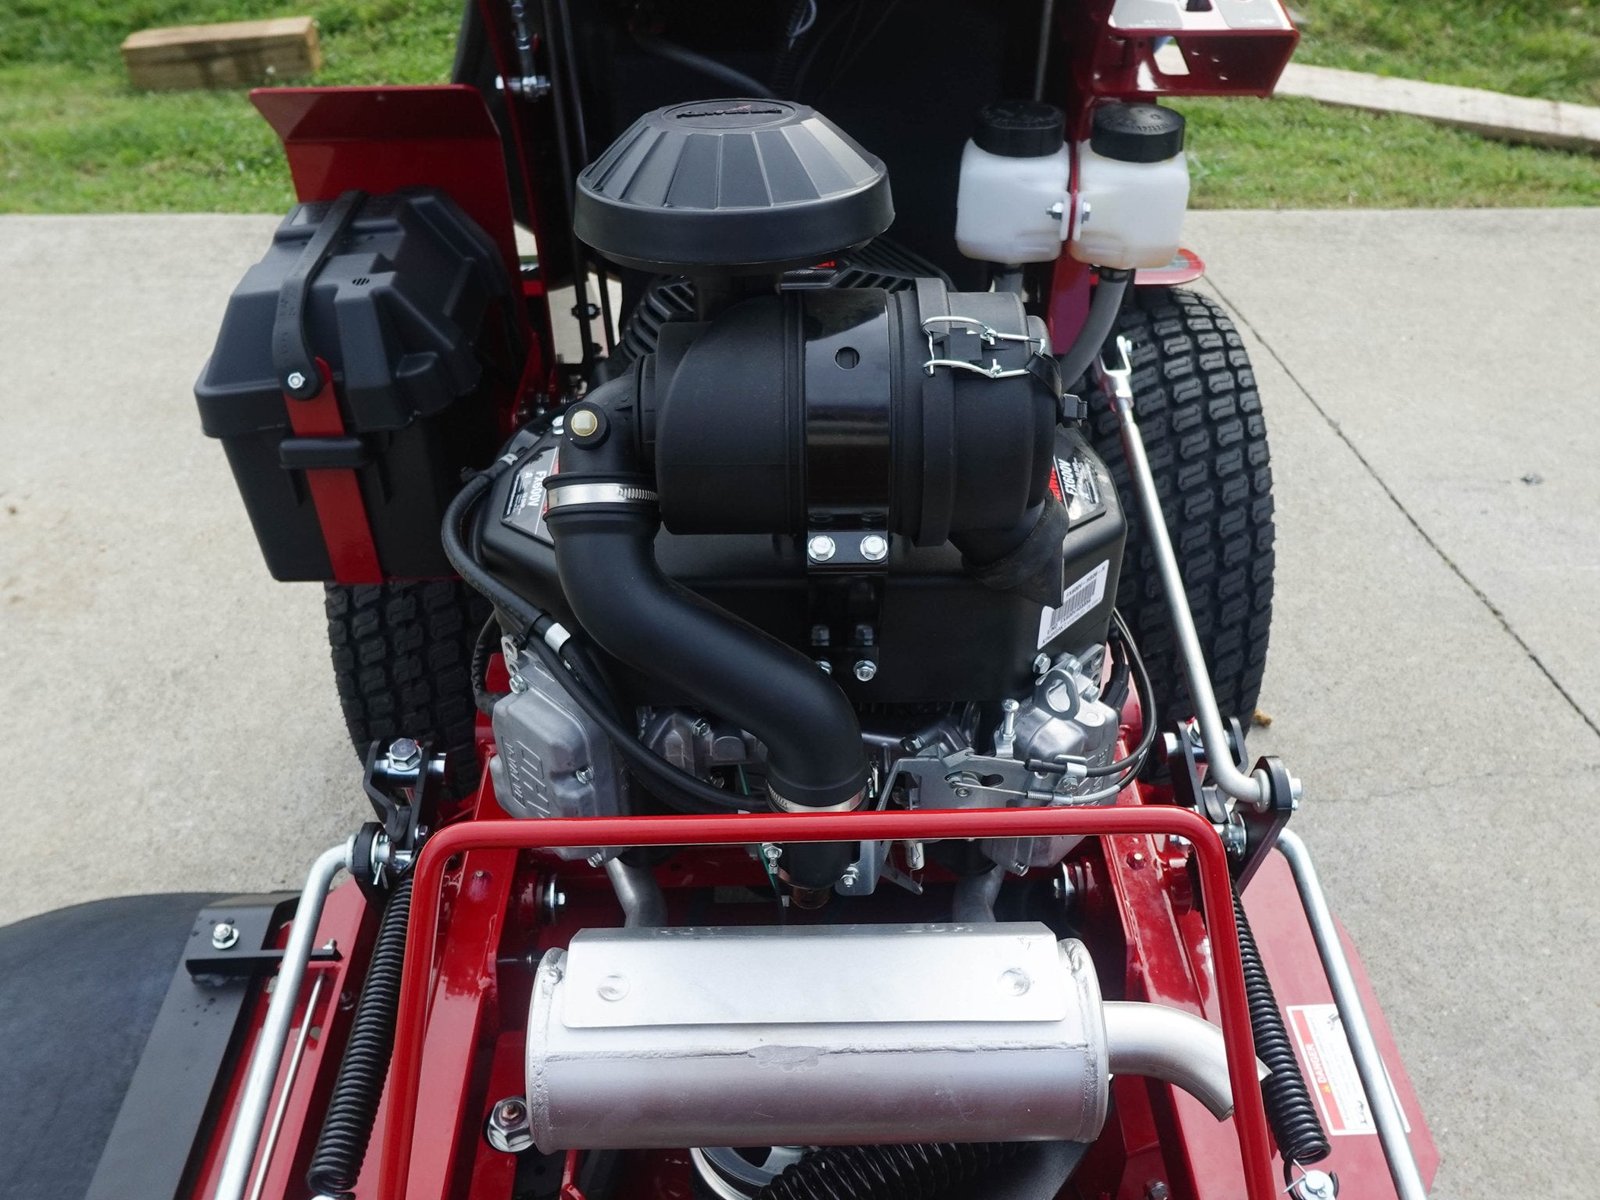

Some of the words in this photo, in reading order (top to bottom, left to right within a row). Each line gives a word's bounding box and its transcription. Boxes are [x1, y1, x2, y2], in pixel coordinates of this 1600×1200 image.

[527, 470, 548, 507] FX600V
[1057, 458, 1079, 496] FX600V
[1304, 1043, 1328, 1084] DANGER
